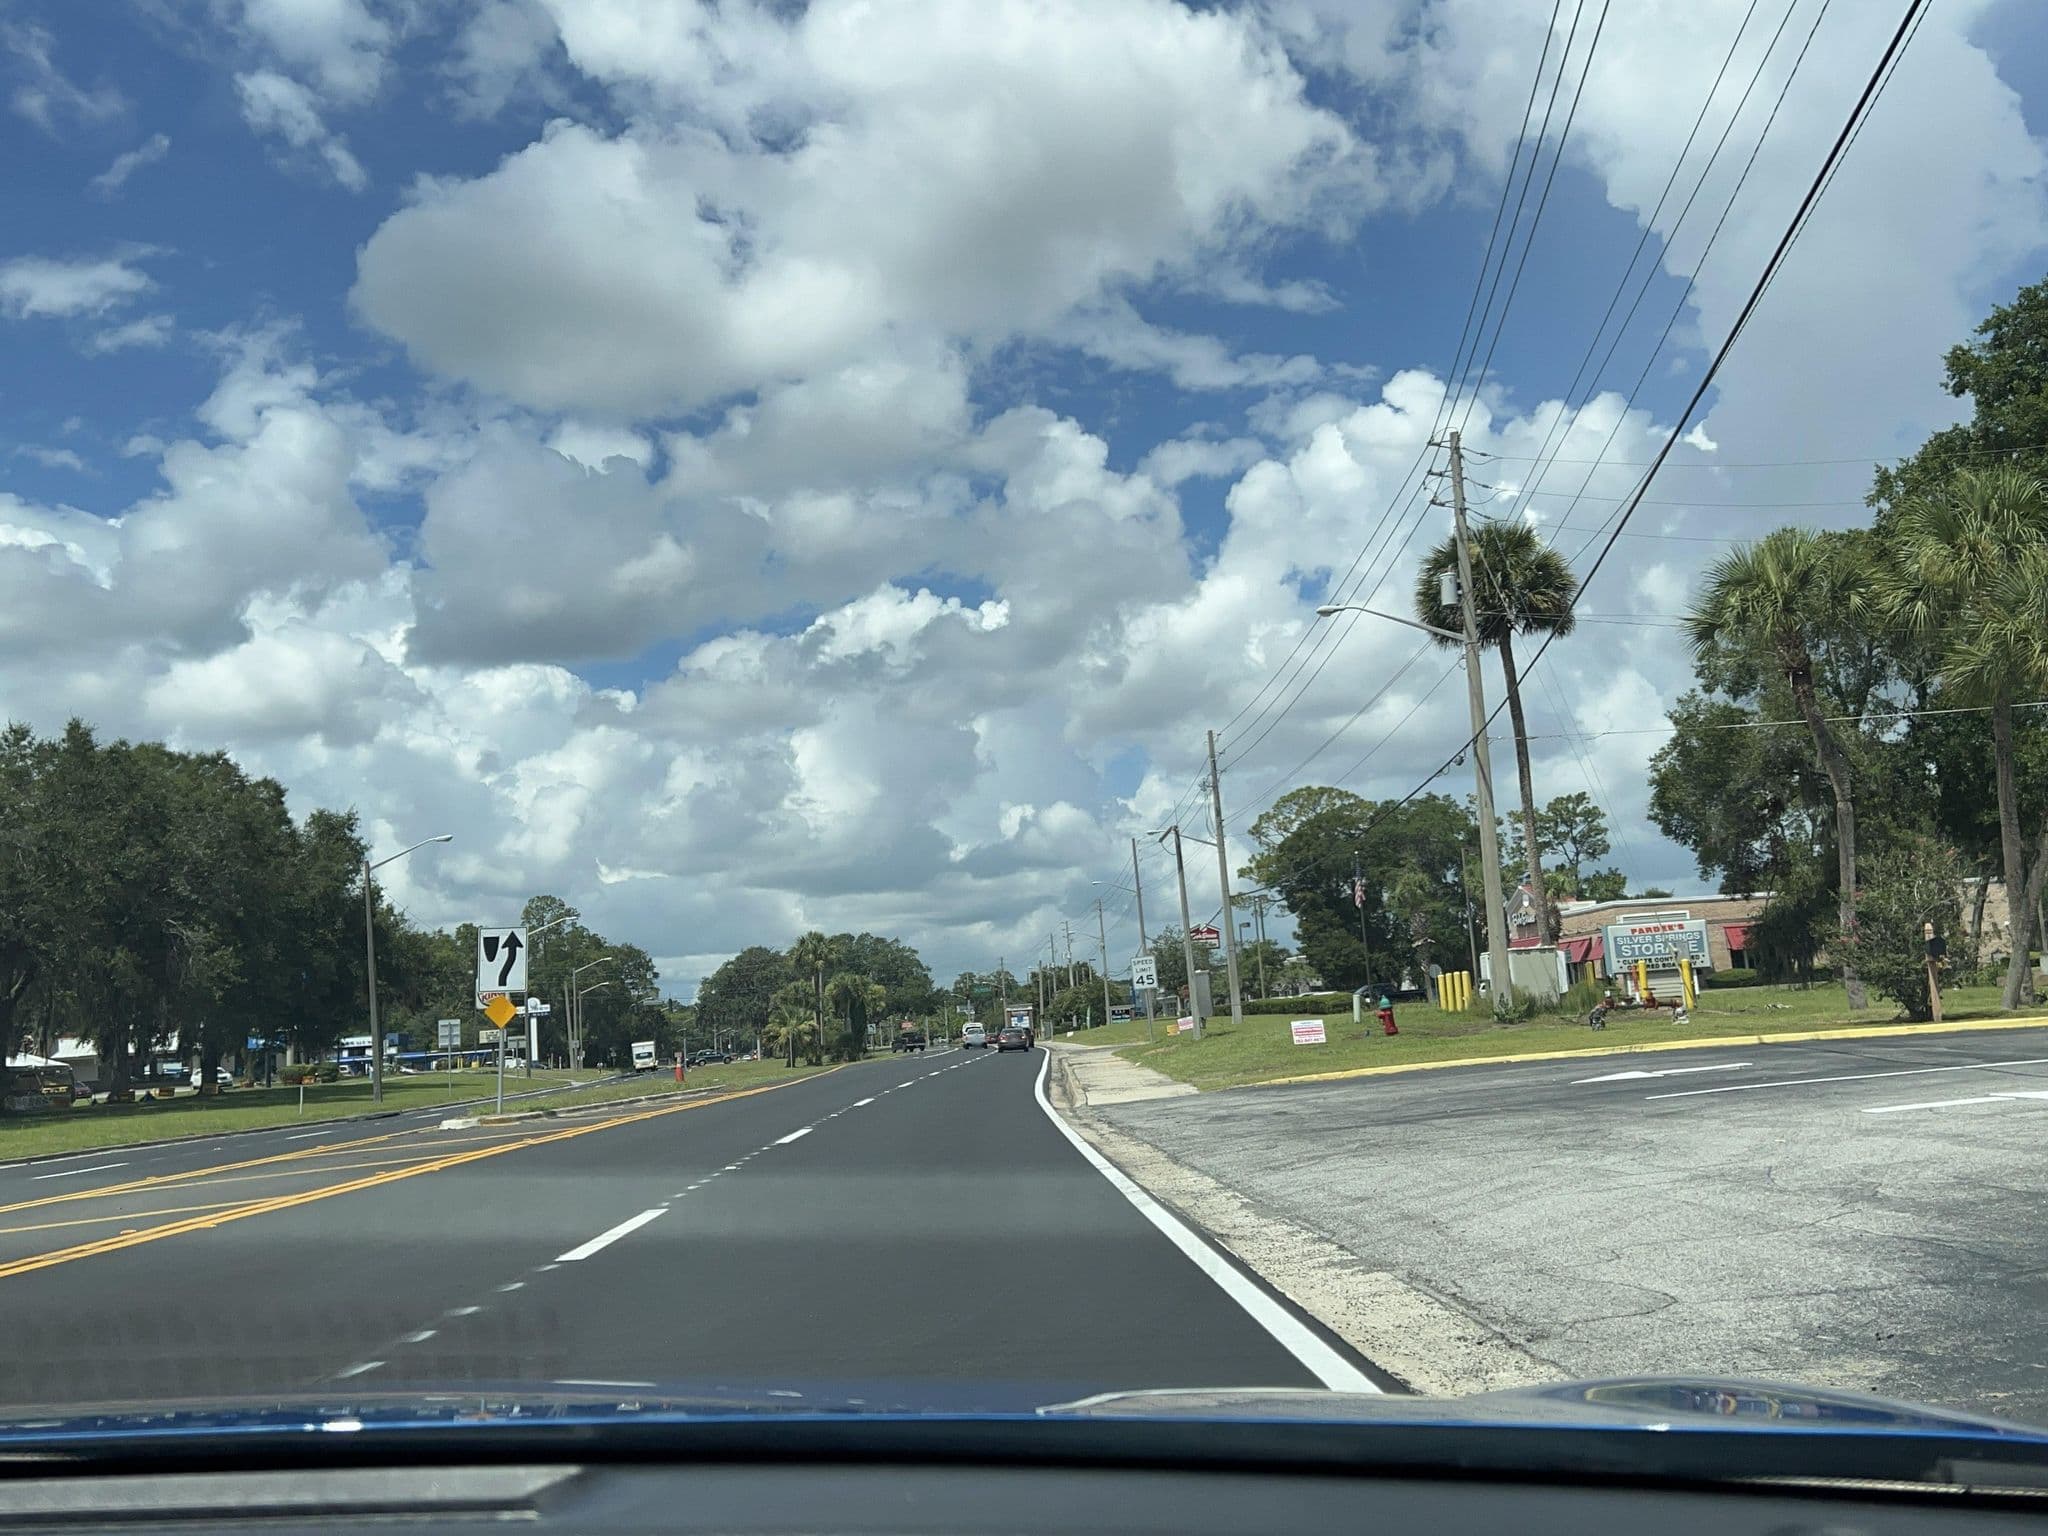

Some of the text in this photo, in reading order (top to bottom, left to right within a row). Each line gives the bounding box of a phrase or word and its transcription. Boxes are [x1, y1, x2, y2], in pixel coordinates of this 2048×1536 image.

[1630, 923, 1685, 935] PARDEE'S
[1616, 931, 1701, 945] SILVER SPRINGS
[1621, 940, 1699, 956] STORE
[1135, 975, 1155, 985] 45
